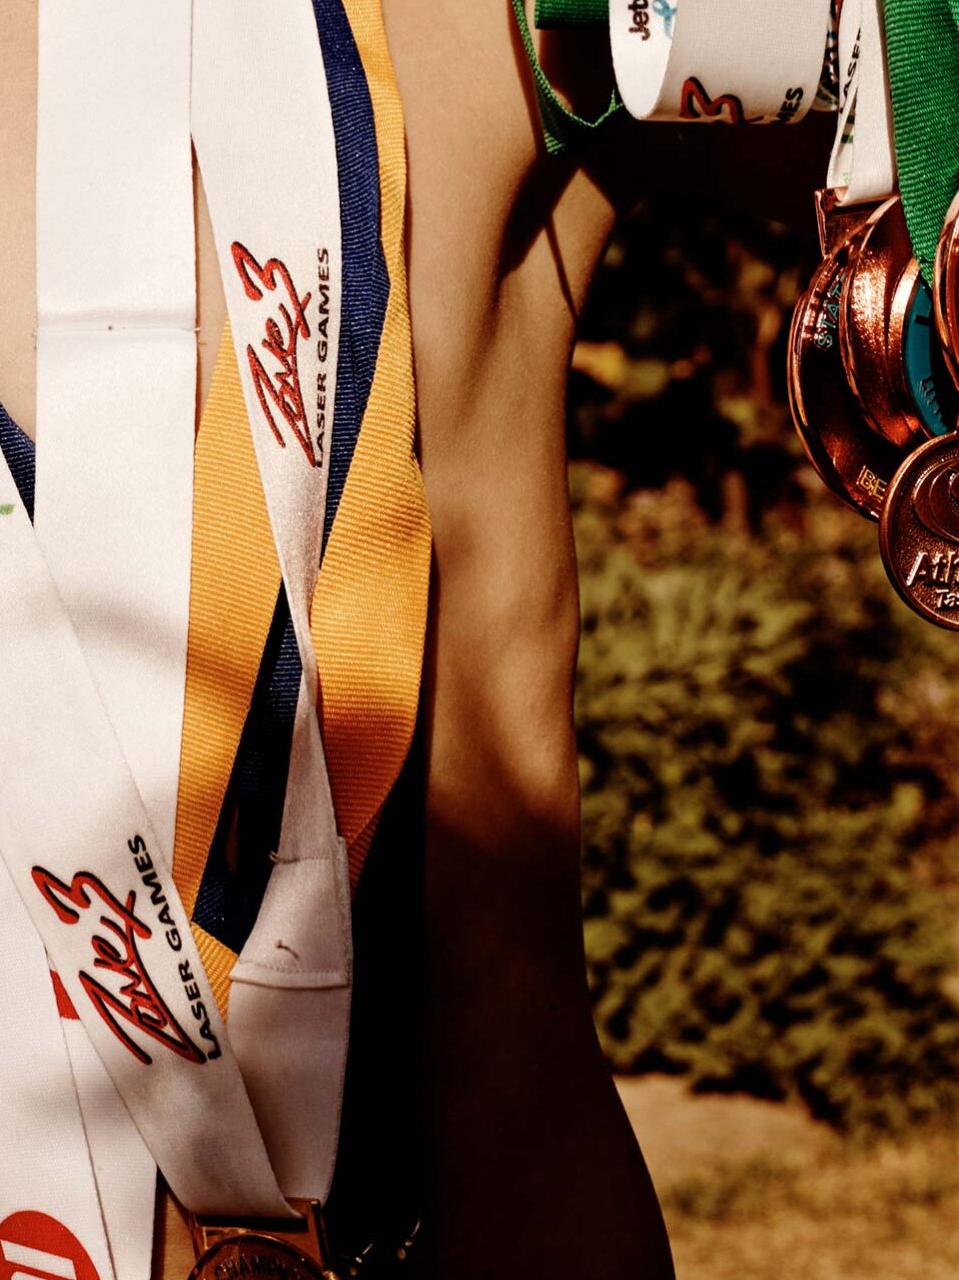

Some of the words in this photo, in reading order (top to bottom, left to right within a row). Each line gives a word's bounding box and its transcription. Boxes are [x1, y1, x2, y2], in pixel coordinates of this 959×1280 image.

[317, 247, 329, 363] GAMES
[316, 375, 328, 468] LASER
[128, 834, 182, 952] GAMES
[178, 960, 222, 1060] LASER
